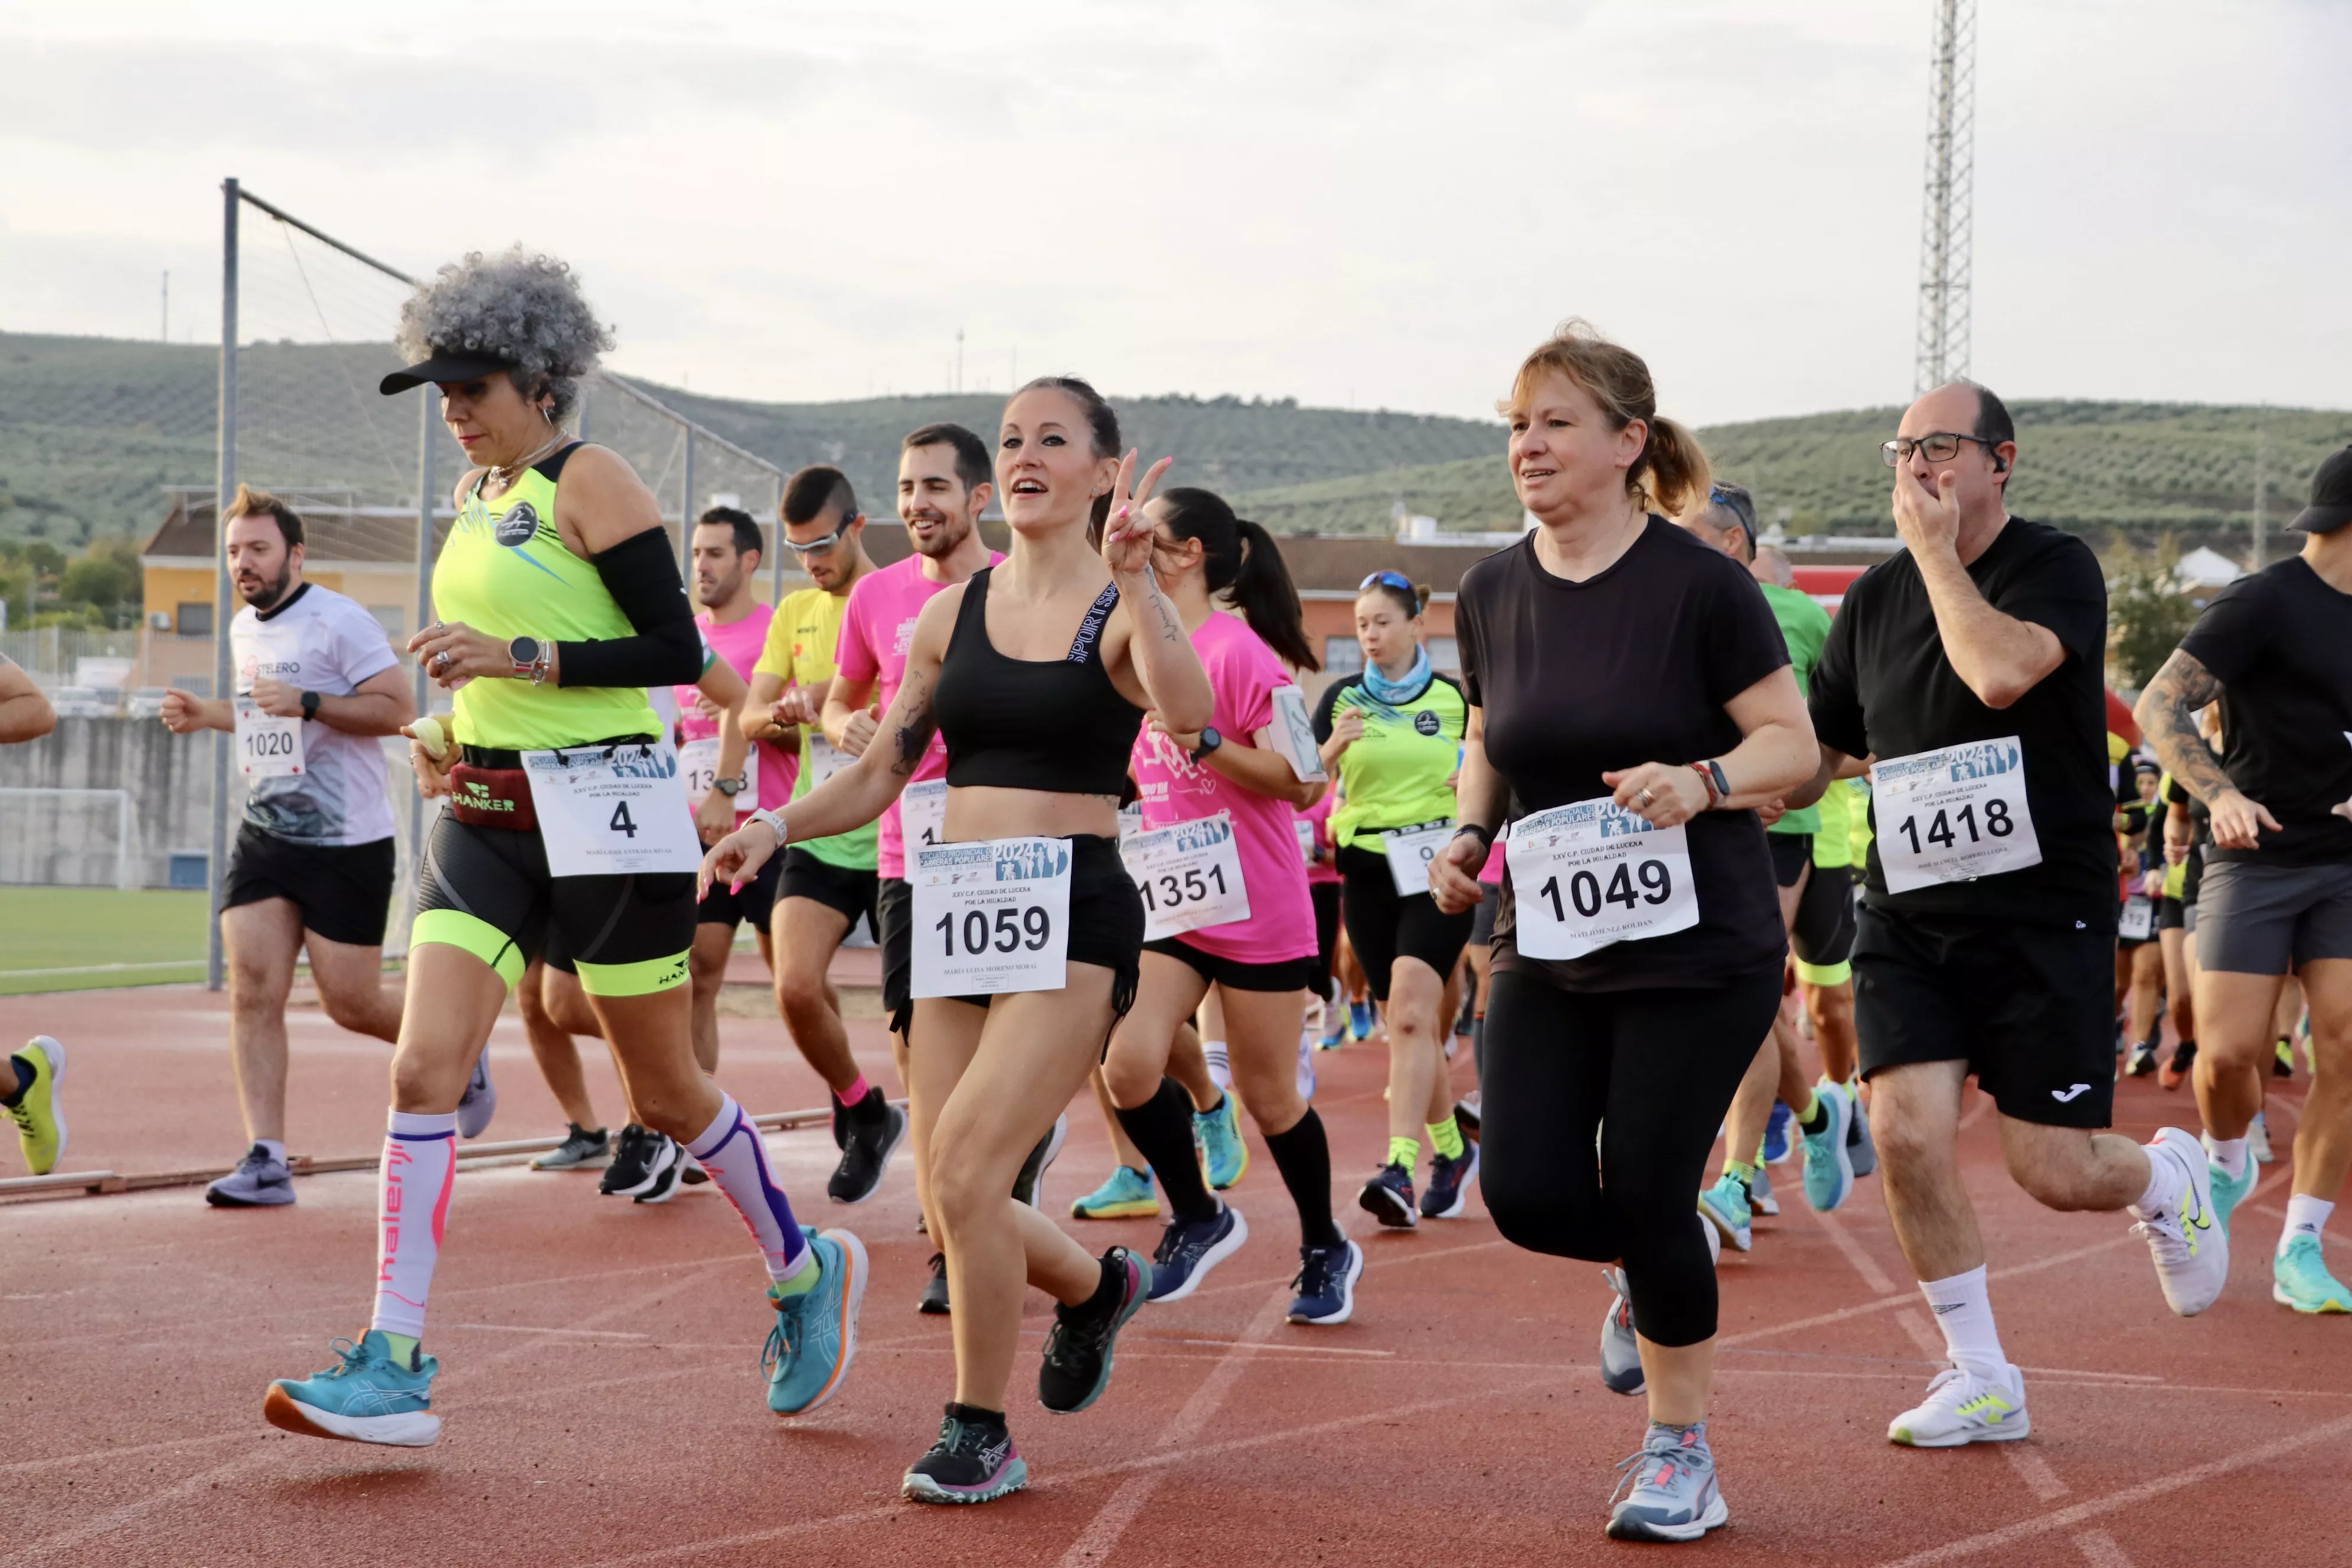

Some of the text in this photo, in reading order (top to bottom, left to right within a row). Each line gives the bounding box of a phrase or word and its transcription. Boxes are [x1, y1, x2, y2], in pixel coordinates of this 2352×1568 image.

[247, 731, 293, 756] 1020
[1949, 747, 1986, 766] 2024
[452, 791, 515, 812] HANKER
[1544, 806, 1584, 822] PROVINCIAL
[1586, 804, 1596, 813] DE
[1596, 802, 1629, 820] 202
[610, 801, 638, 838] 4
[1551, 812, 1596, 827] POPULARES
[1900, 799, 2014, 854] 1418
[919, 851, 946, 861] CIRCUITO
[948, 848, 984, 857] PROVINCIAL
[994, 843, 1035, 862] 2024
[920, 854, 994, 868] CARRERAS POPULARES
[1553, 852, 1566, 861] XXV
[1580, 846, 1605, 855] CIUDAD
[1616, 840, 1644, 849] LUCENA
[1568, 859, 1581, 867] POR
[1593, 852, 1627, 863] IGUALDAD
[1140, 864, 1227, 912] 1351
[1540, 860, 1671, 922] 1049
[936, 906, 1050, 956] 1059
[945, 966, 965, 975] MARÍA
[966, 965, 984, 974] LUISA
[986, 964, 1014, 972] MORENO
